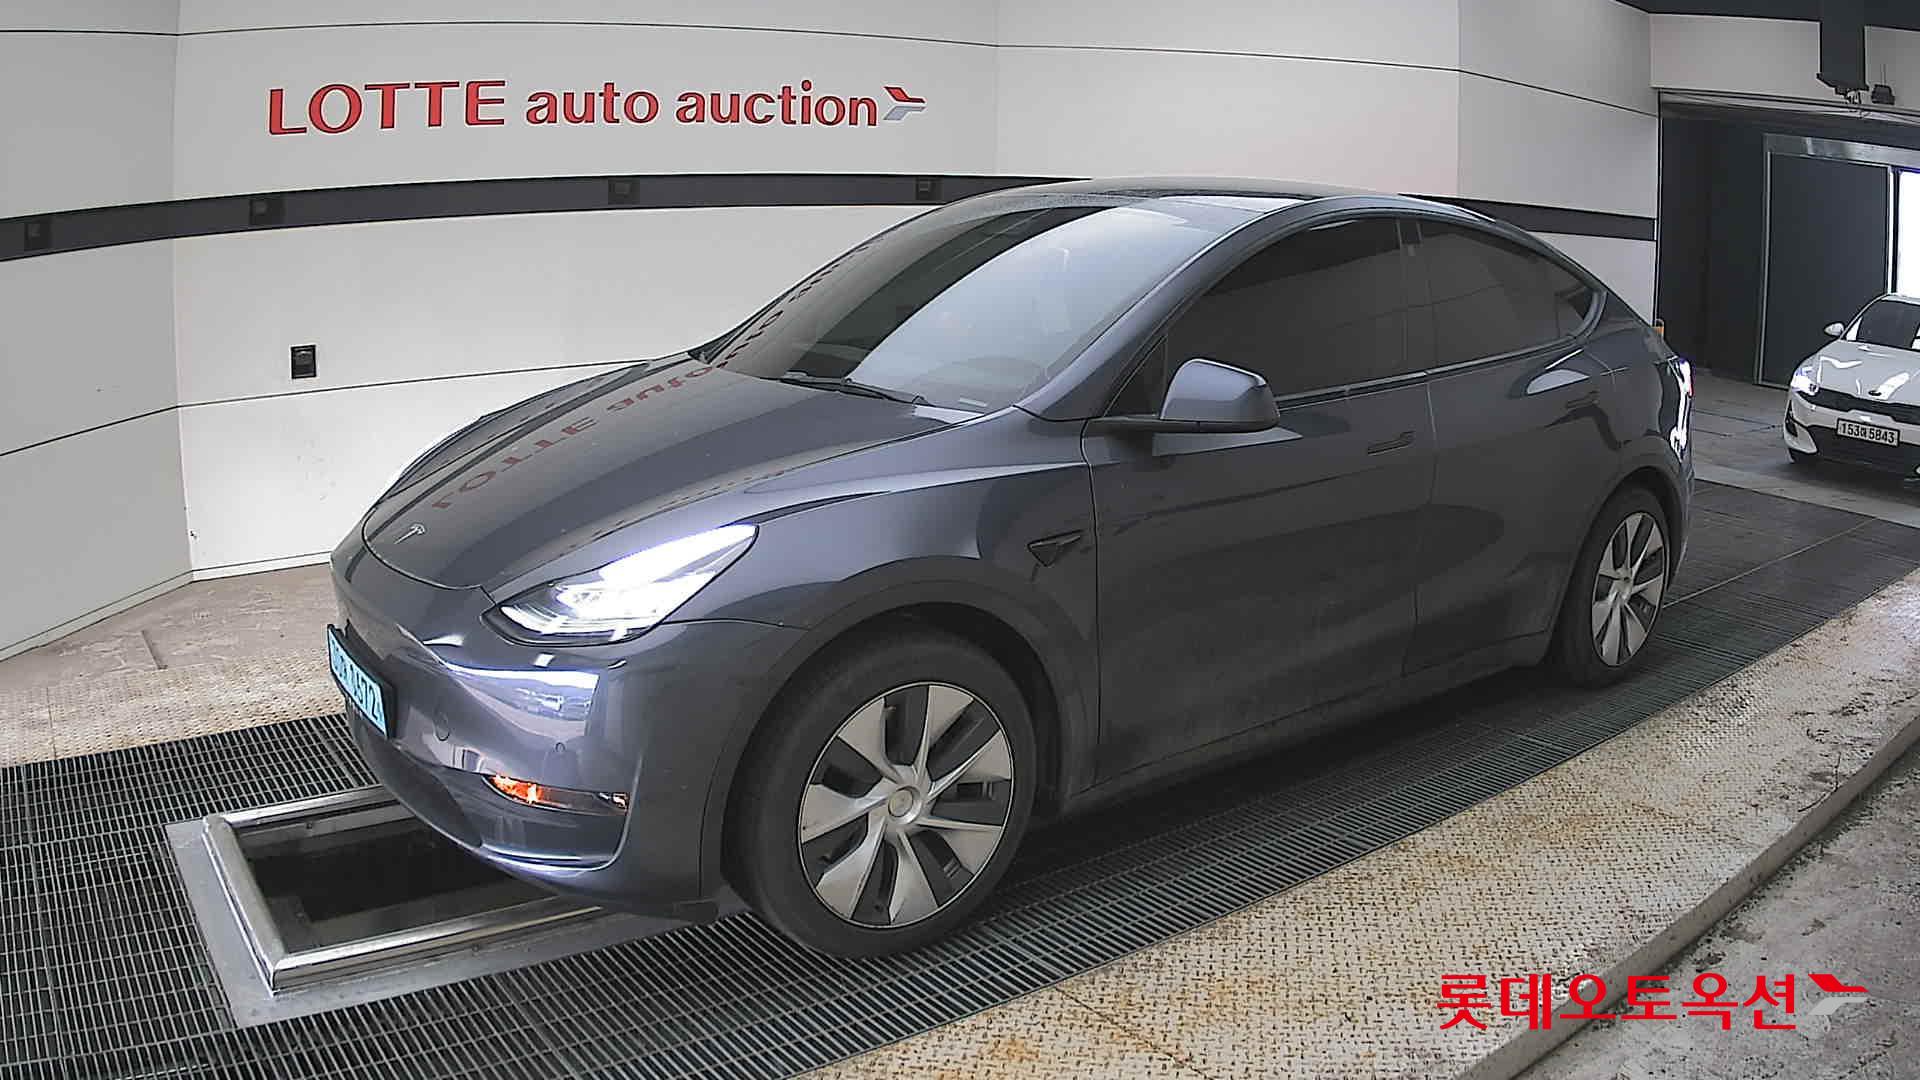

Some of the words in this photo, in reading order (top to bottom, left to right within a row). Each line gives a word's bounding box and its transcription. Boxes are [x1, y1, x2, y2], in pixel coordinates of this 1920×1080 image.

[267, 80, 505, 135] LOTTE
[526, 82, 659, 125] auto
[676, 80, 878, 126] auction
